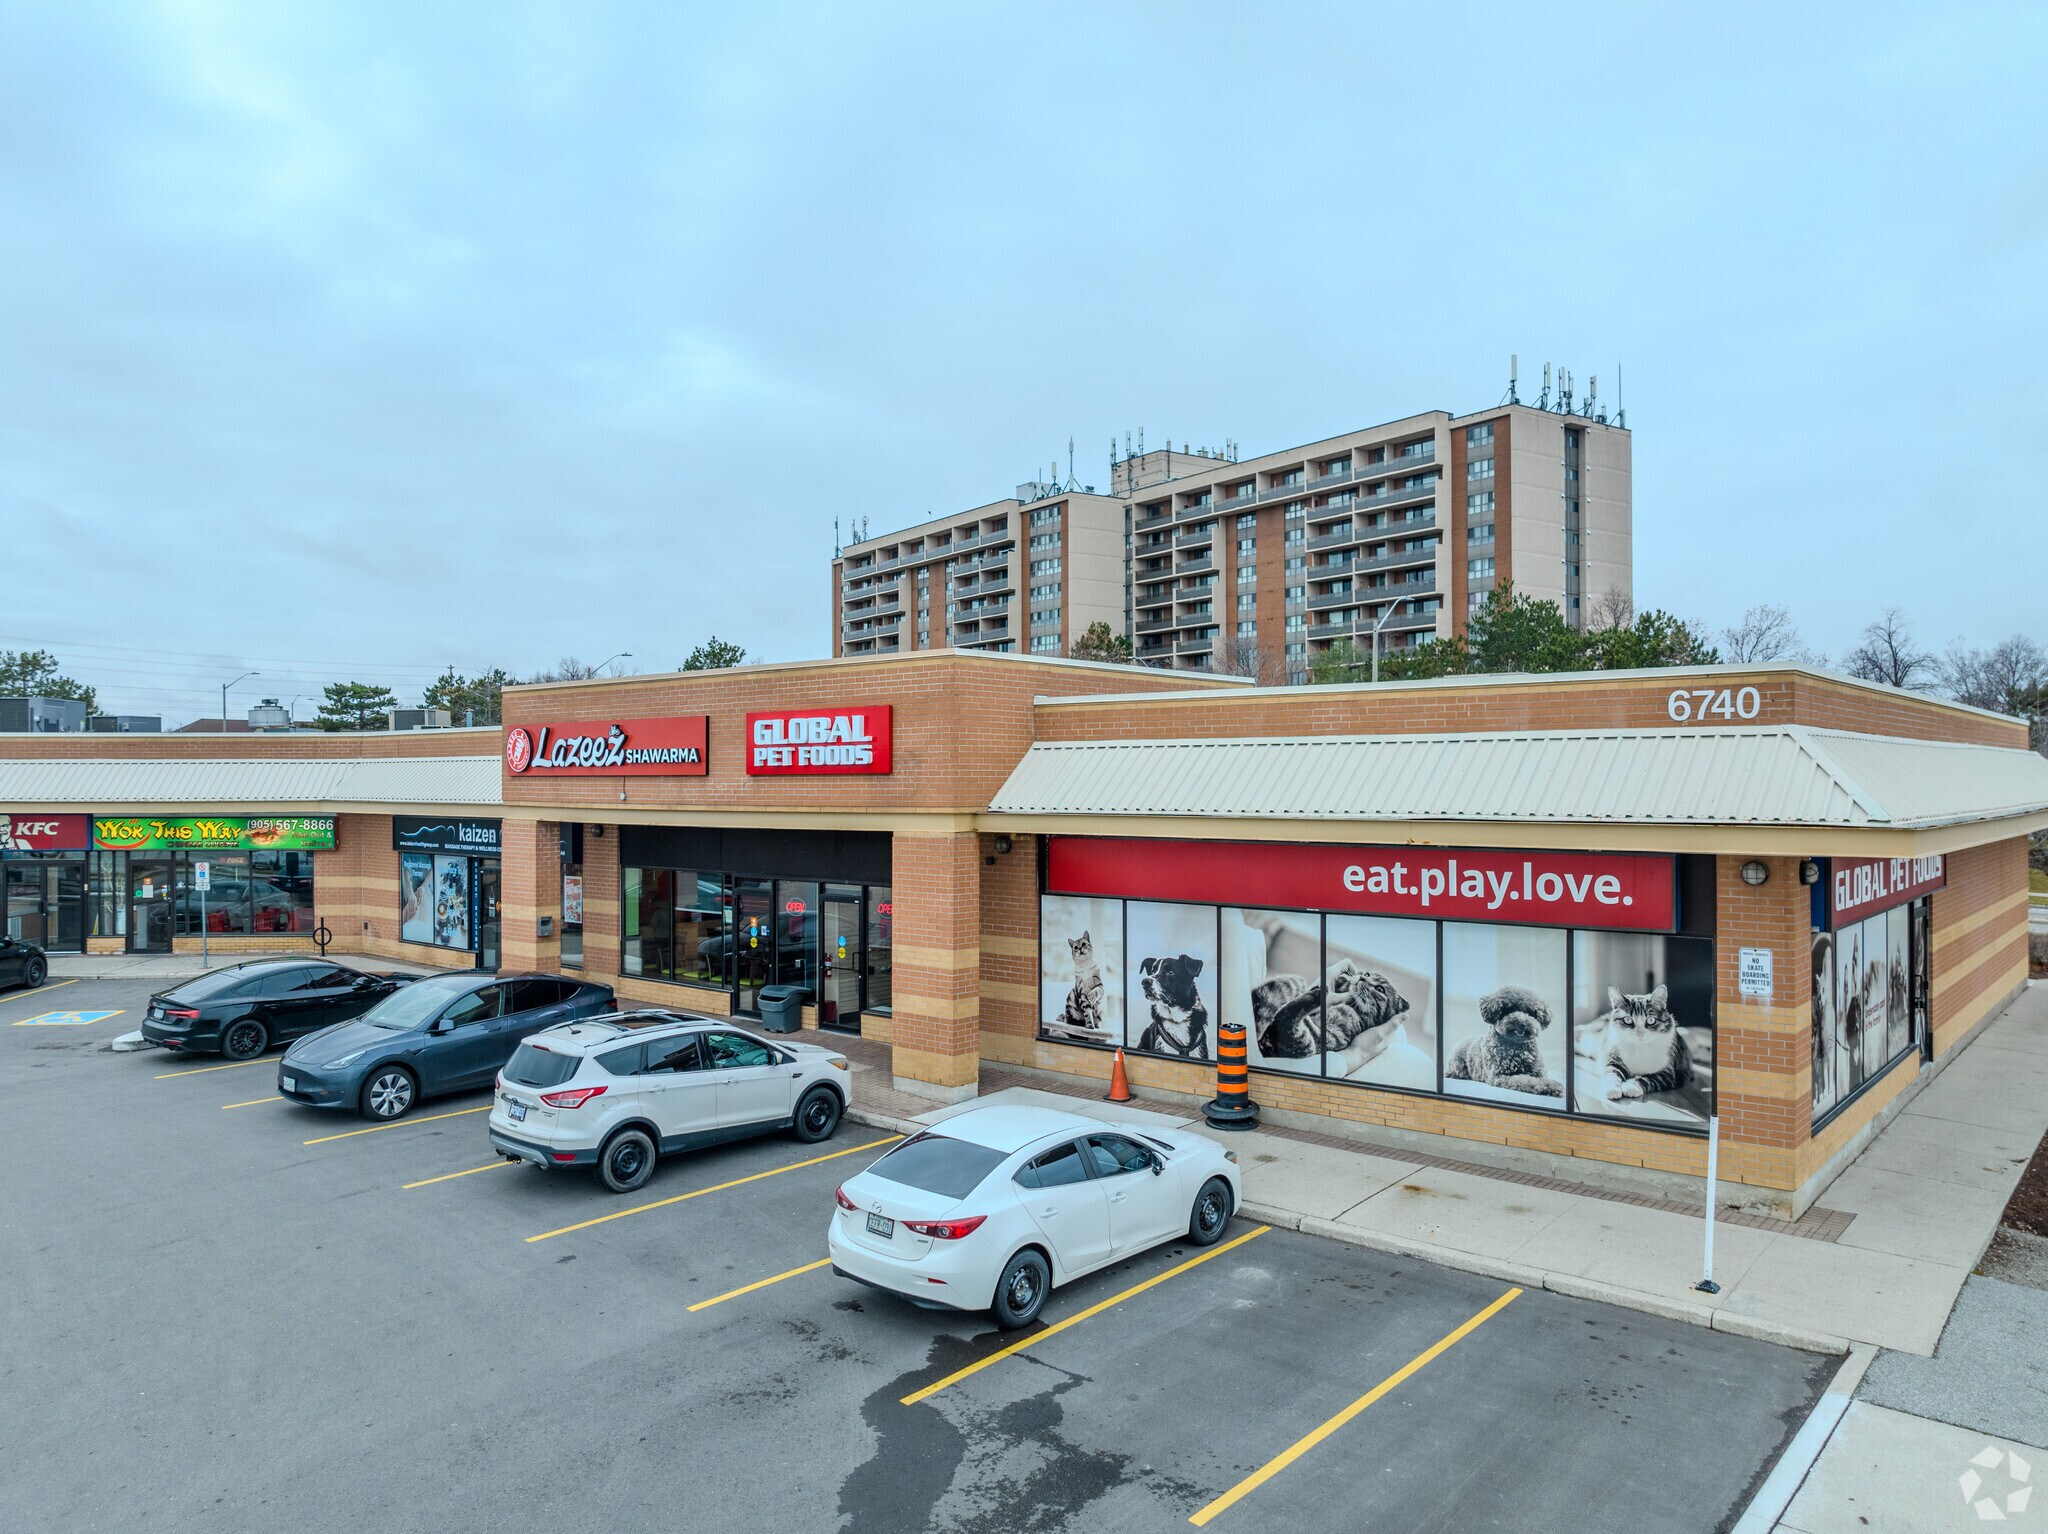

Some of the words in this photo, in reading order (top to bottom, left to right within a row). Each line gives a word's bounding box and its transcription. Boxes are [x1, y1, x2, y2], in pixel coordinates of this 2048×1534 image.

[1668, 687, 1760, 722] 6740
[754, 715, 873, 745] GLOBAL
[626, 748, 699, 764] SHAWARMA
[754, 747, 795, 766] PET
[798, 745, 873, 766] FOODS
[15, 822, 60, 836] KFC
[95, 820, 144, 840] WOK
[148, 821, 193, 840] THIS
[195, 821, 242, 840] WAY
[247, 820, 273, 830] (905)
[275, 819, 334, 831] 567-8866
[459, 823, 496, 843] kaizen
[1343, 859, 1633, 909] eat.play.love.
[1835, 862, 1887, 911] GLOBAL
[1890, 858, 1910, 894] PET
[1912, 855, 1942, 885] FOODS
[786, 901, 805, 913] OPEN
[877, 903, 892, 914] OPE
[1741, 979, 1770, 987] PERMITTED
[1742, 971, 1769, 979] BOARDING
